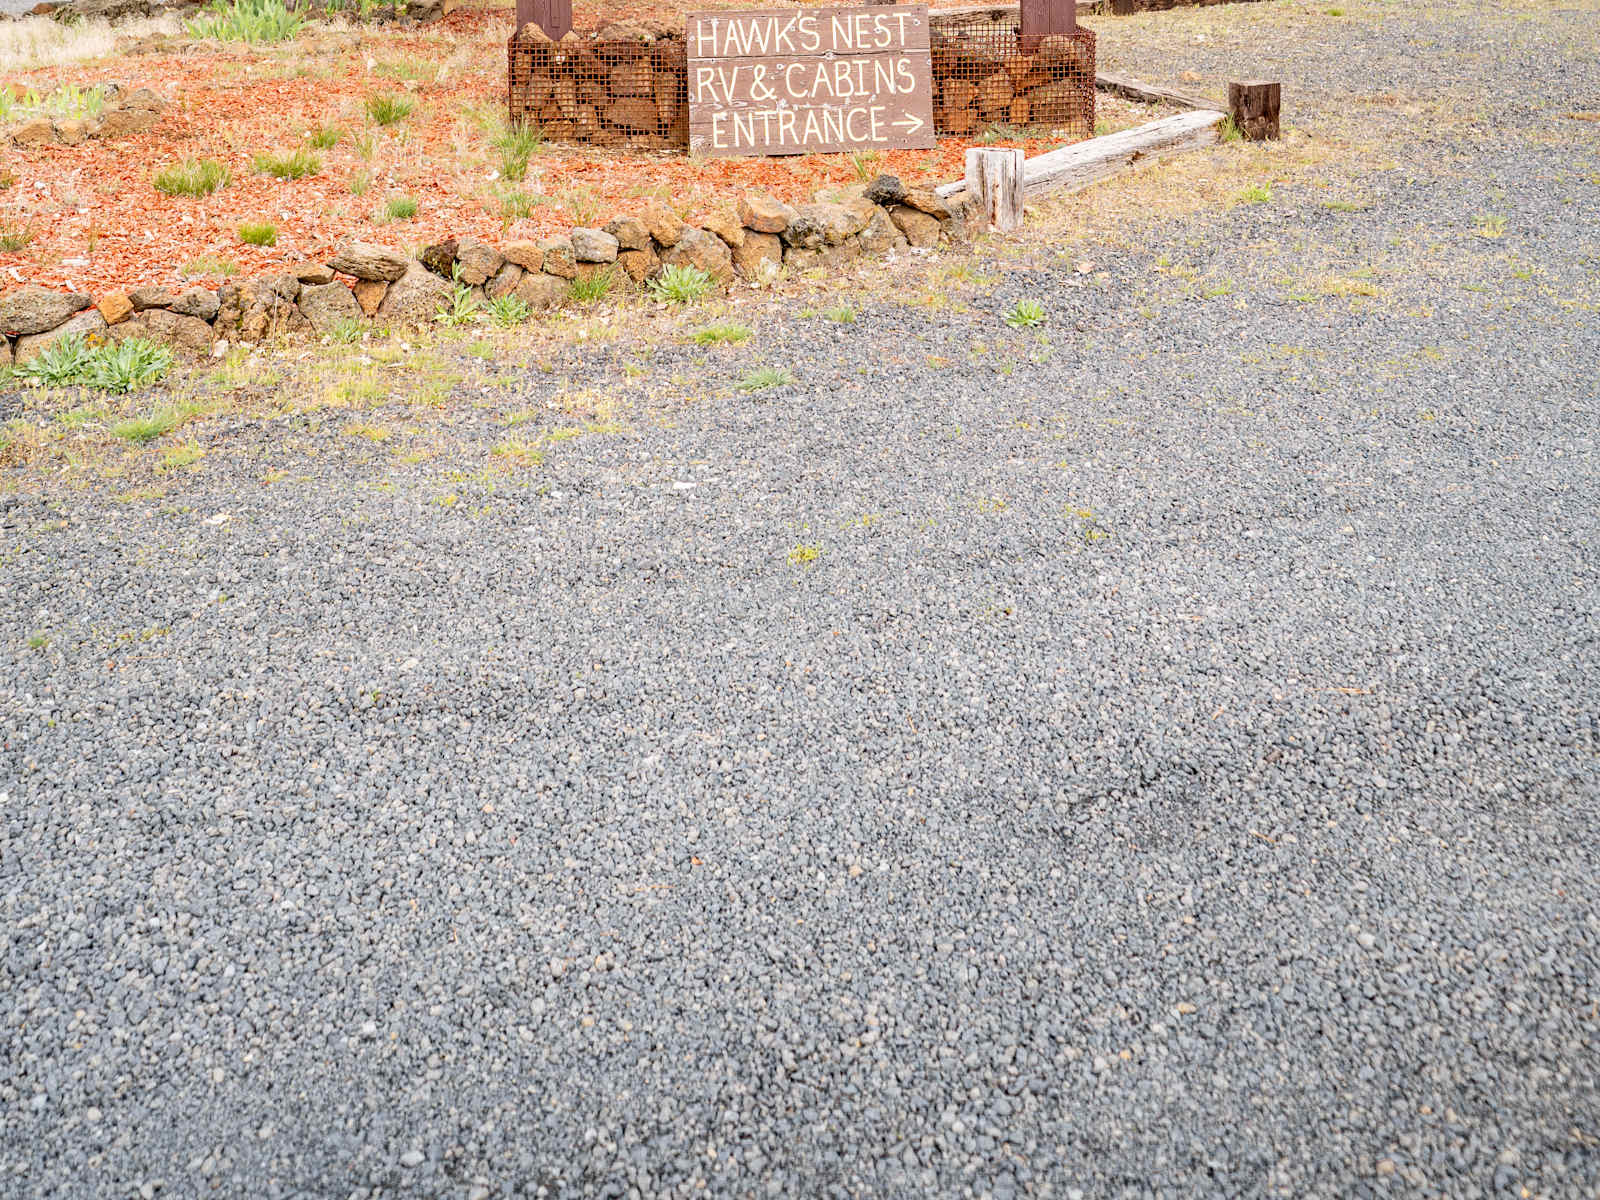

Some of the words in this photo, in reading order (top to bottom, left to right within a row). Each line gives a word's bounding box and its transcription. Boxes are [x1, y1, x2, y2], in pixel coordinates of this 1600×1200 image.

[697, 10, 820, 57] HAWK'S
[832, 12, 911, 50] NEST
[697, 67, 738, 105] RV
[750, 64, 777, 101] &
[785, 58, 915, 98] CABINS
[712, 106, 888, 148] ENTRANCE
